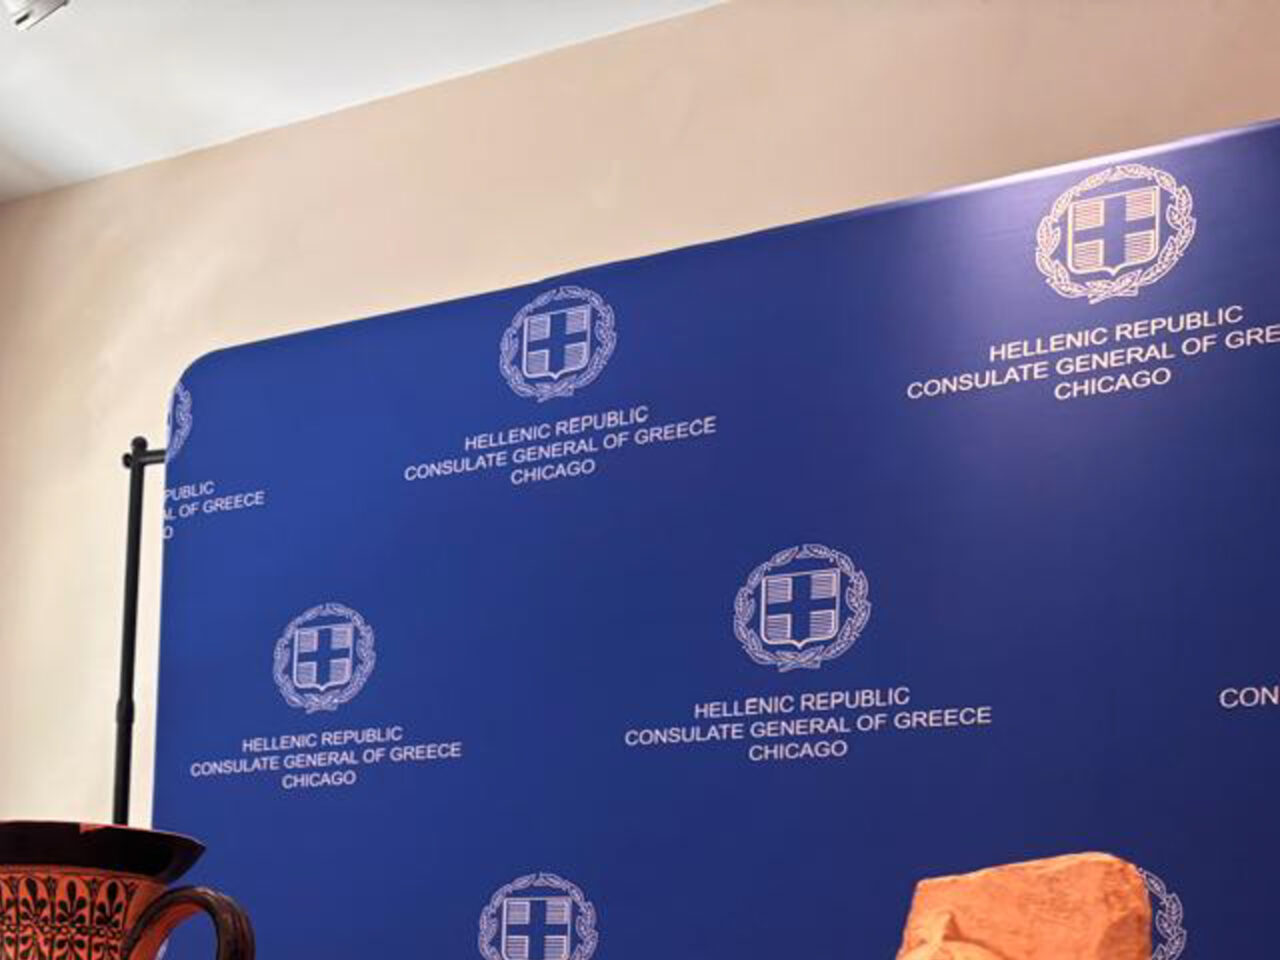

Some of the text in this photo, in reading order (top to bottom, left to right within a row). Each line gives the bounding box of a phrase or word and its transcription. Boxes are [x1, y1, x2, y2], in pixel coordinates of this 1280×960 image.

[990, 304, 1243, 362] HELLENIC REPUBLIC
[907, 361, 1048, 398] CONSULATE
[1056, 342, 1175, 375] GENERAL
[1182, 334, 1217, 355] OF
[1054, 368, 1171, 400] CHICAGO
[465, 406, 648, 451] HELLENIC REPUBLIC
[404, 416, 716, 480] CONSULATE GENERAL OF GREECE
[510, 459, 595, 484] CHICAGO
[179, 502, 200, 518] OF
[202, 491, 264, 513] GREECE
[694, 687, 910, 718] HELLENIC REPUBLIC
[242, 726, 402, 752] HELLENIC REPUBLIC
[625, 706, 991, 746] CONSULATE GENERAL OF GREECE
[190, 742, 461, 777] CONSULATE GENERAL OF GREECE
[749, 740, 848, 761] CHICAGO
[282, 770, 356, 789] CHICAGO
